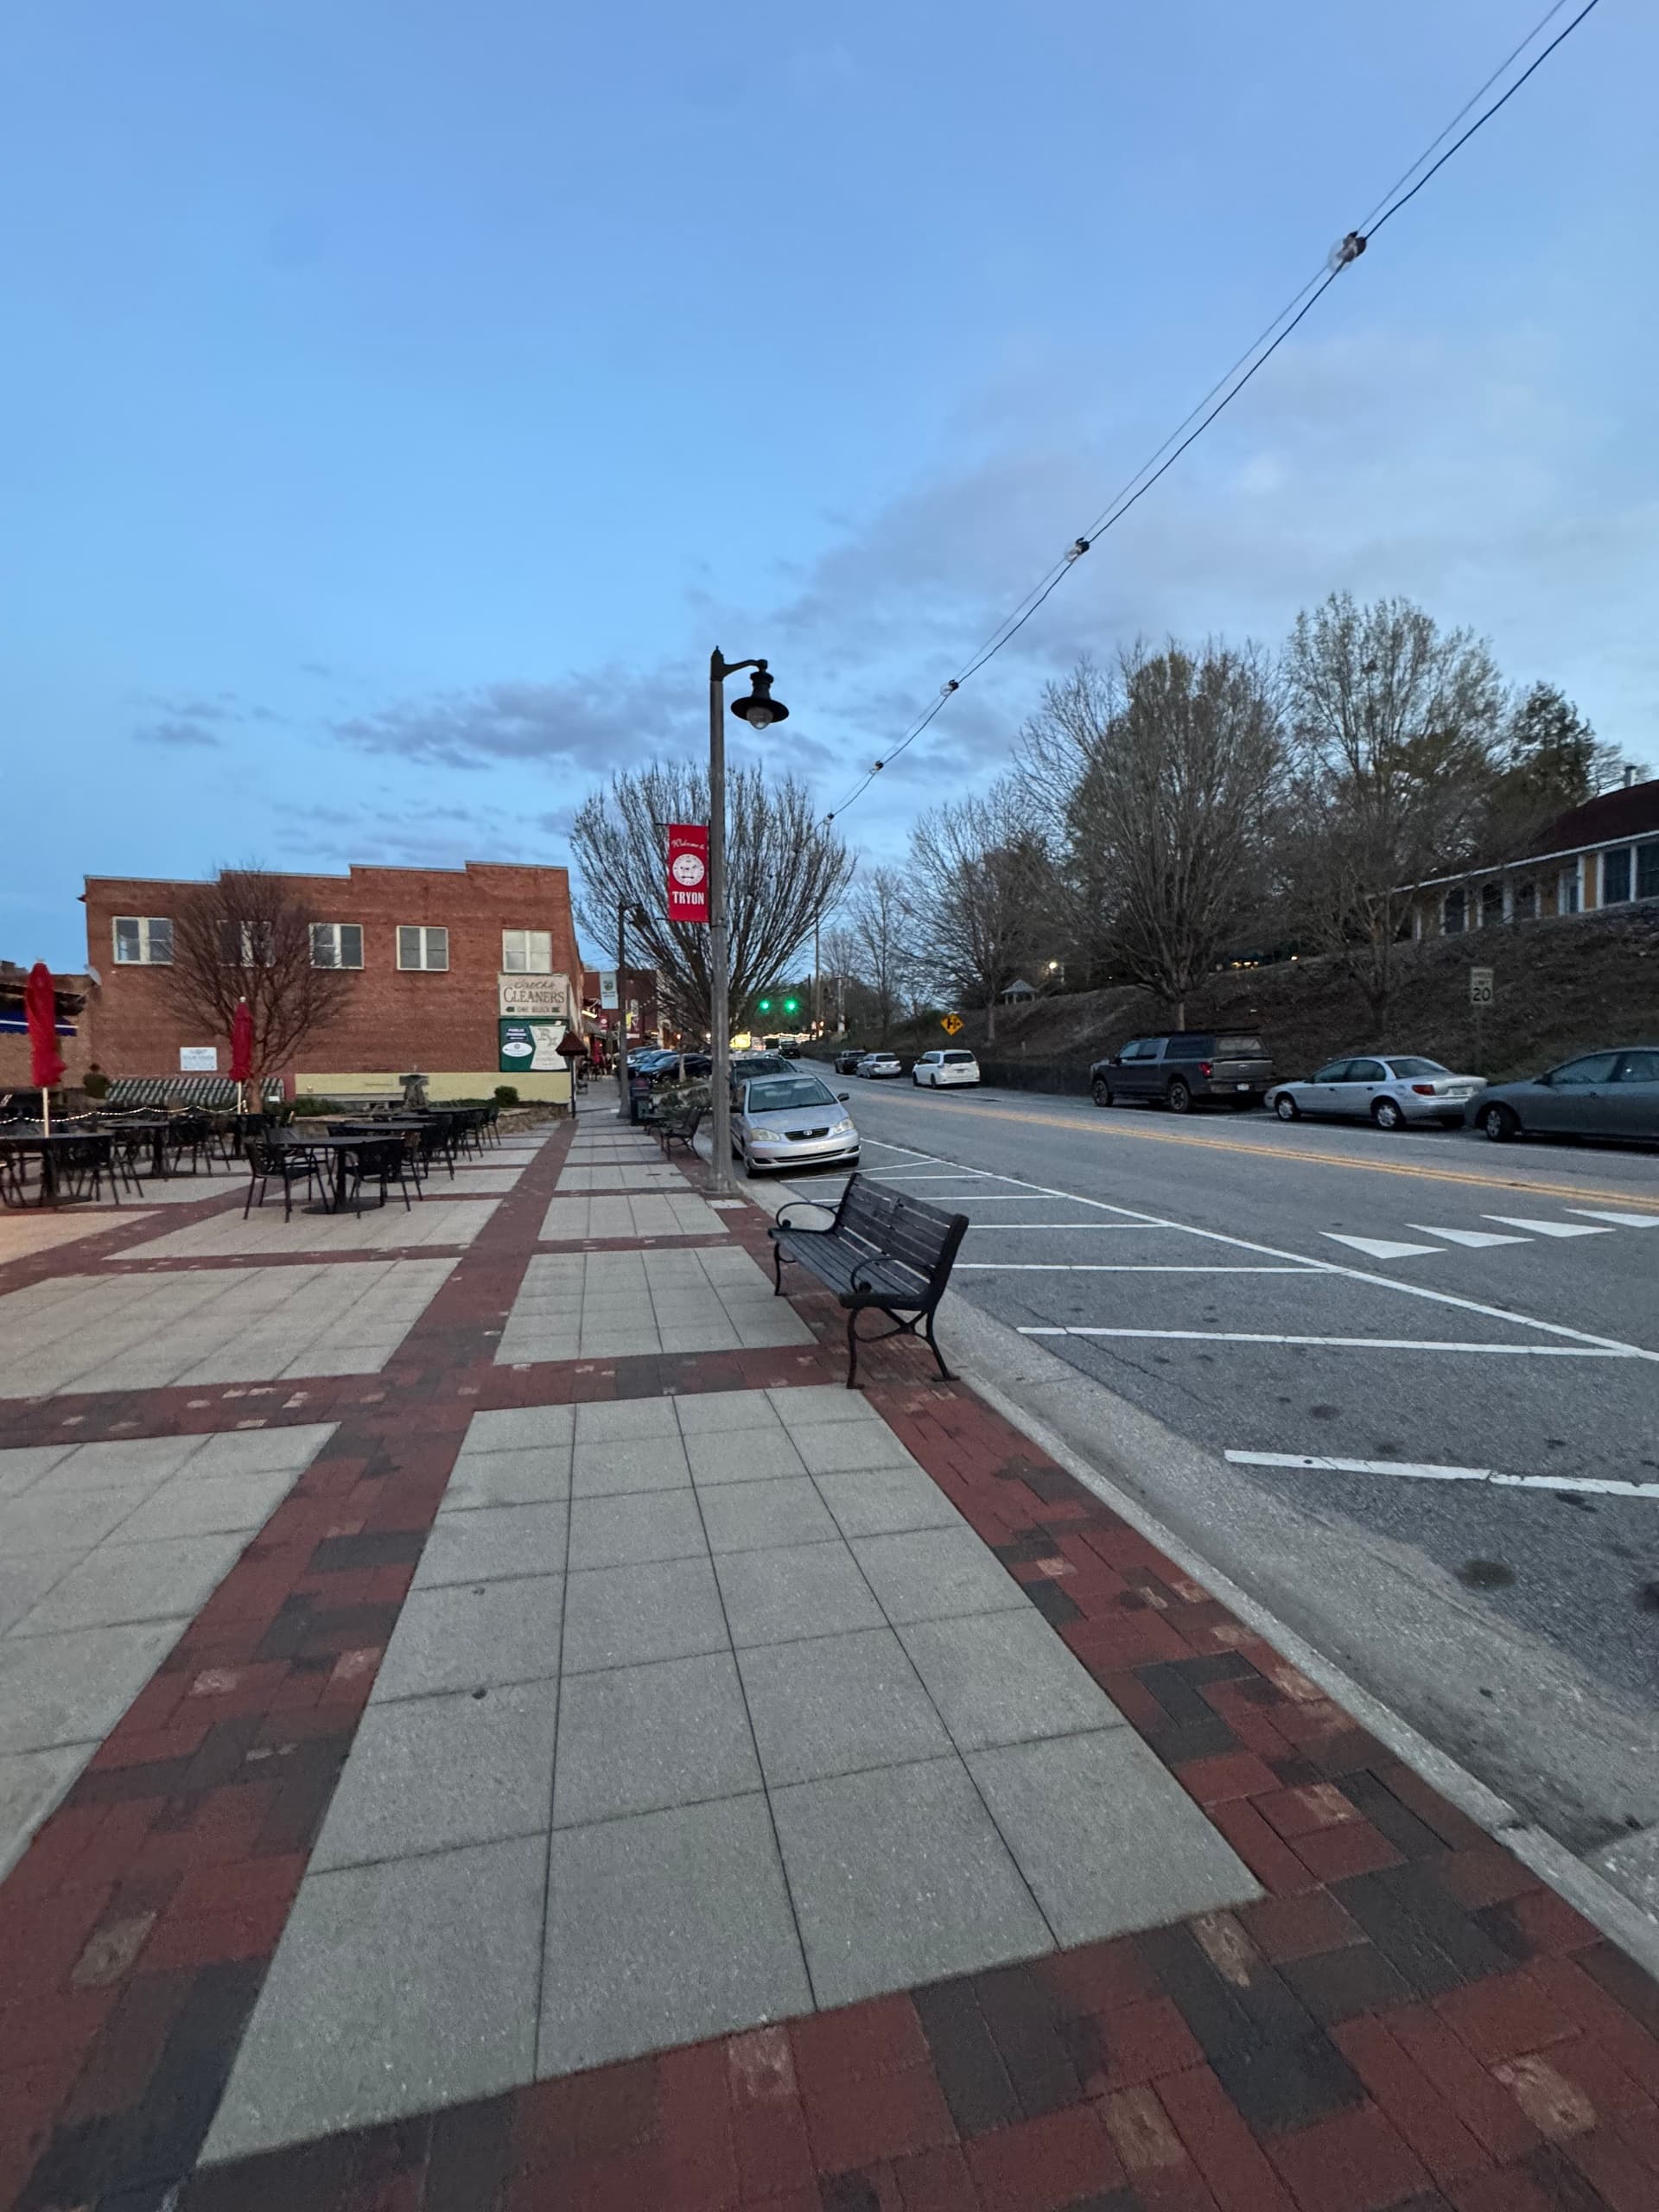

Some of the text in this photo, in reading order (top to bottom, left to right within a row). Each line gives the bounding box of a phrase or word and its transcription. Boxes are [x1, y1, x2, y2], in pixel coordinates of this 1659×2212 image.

[671, 891, 705, 906] TRYON
[503, 987, 565, 1003] CLEANERS
[1473, 987, 1491, 1001] 20
